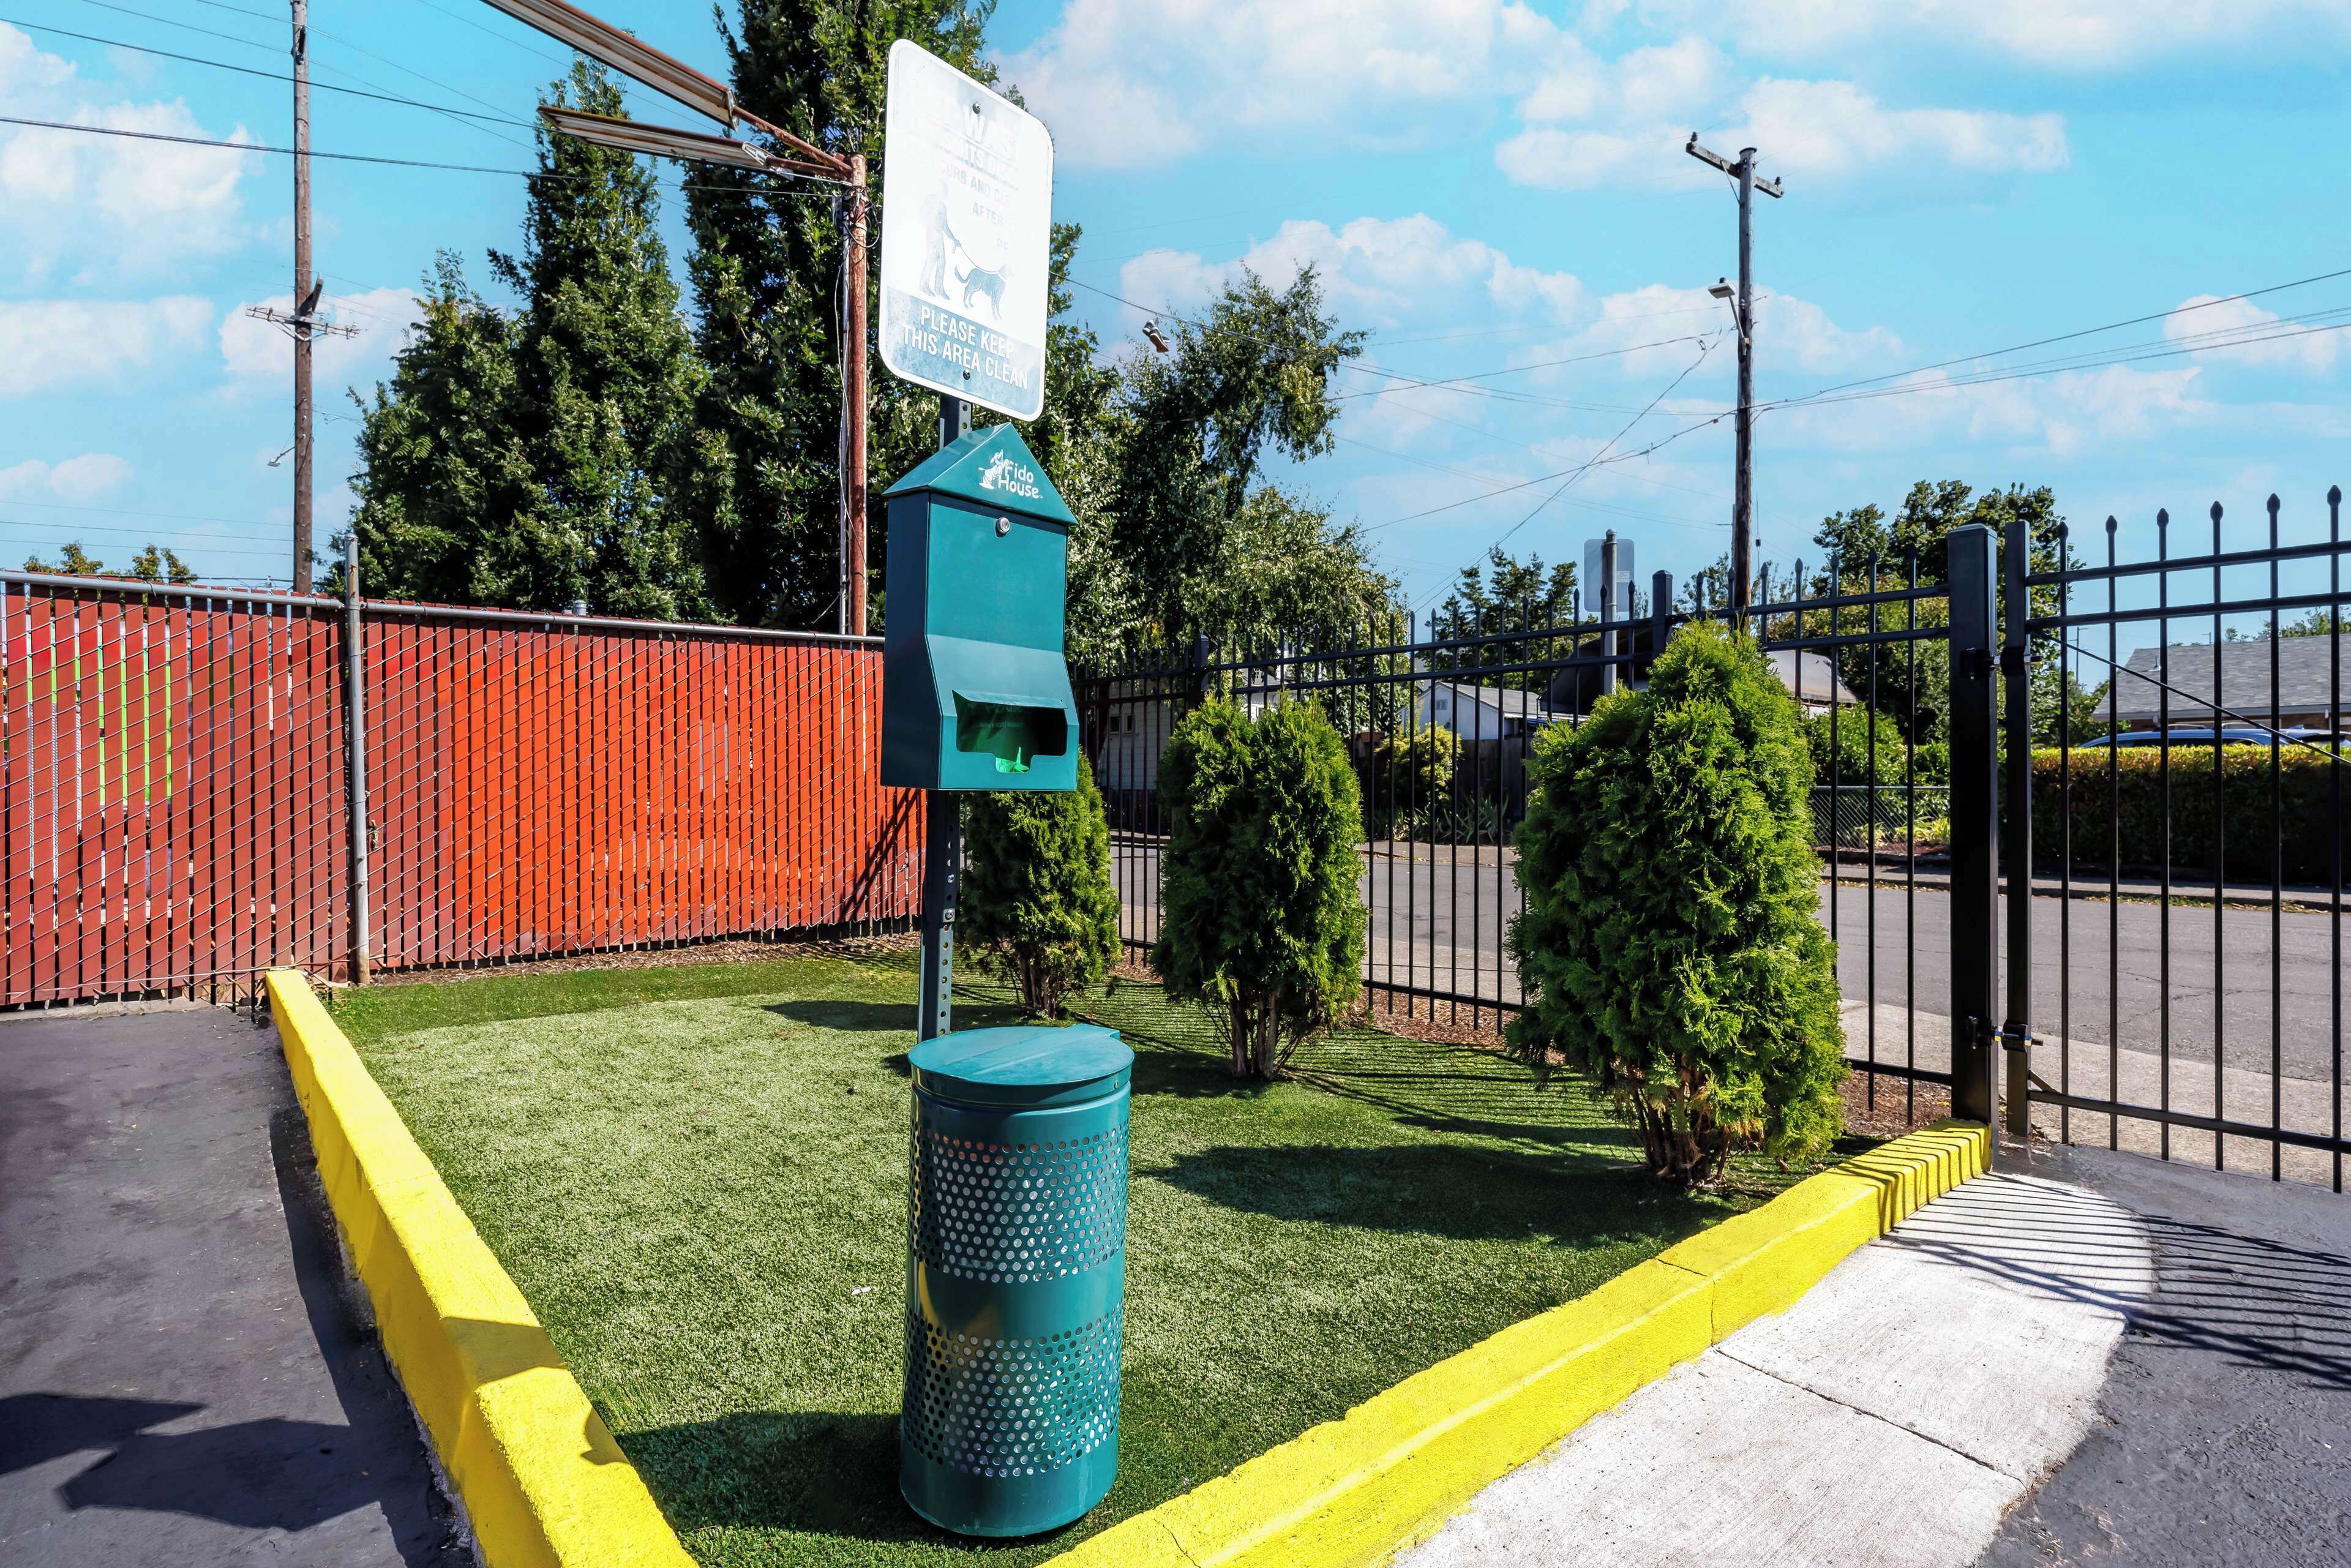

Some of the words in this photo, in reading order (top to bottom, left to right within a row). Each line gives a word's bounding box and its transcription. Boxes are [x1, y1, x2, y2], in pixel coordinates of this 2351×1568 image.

[920, 305, 976, 346] PLEASE
[981, 329, 1014, 360] KEEP
[903, 323, 937, 355] THIS
[942, 340, 981, 372] AREA
[985, 356, 1029, 390] CLEAN
[998, 475, 1039, 499] House
[1005, 460, 1034, 483] Fido
